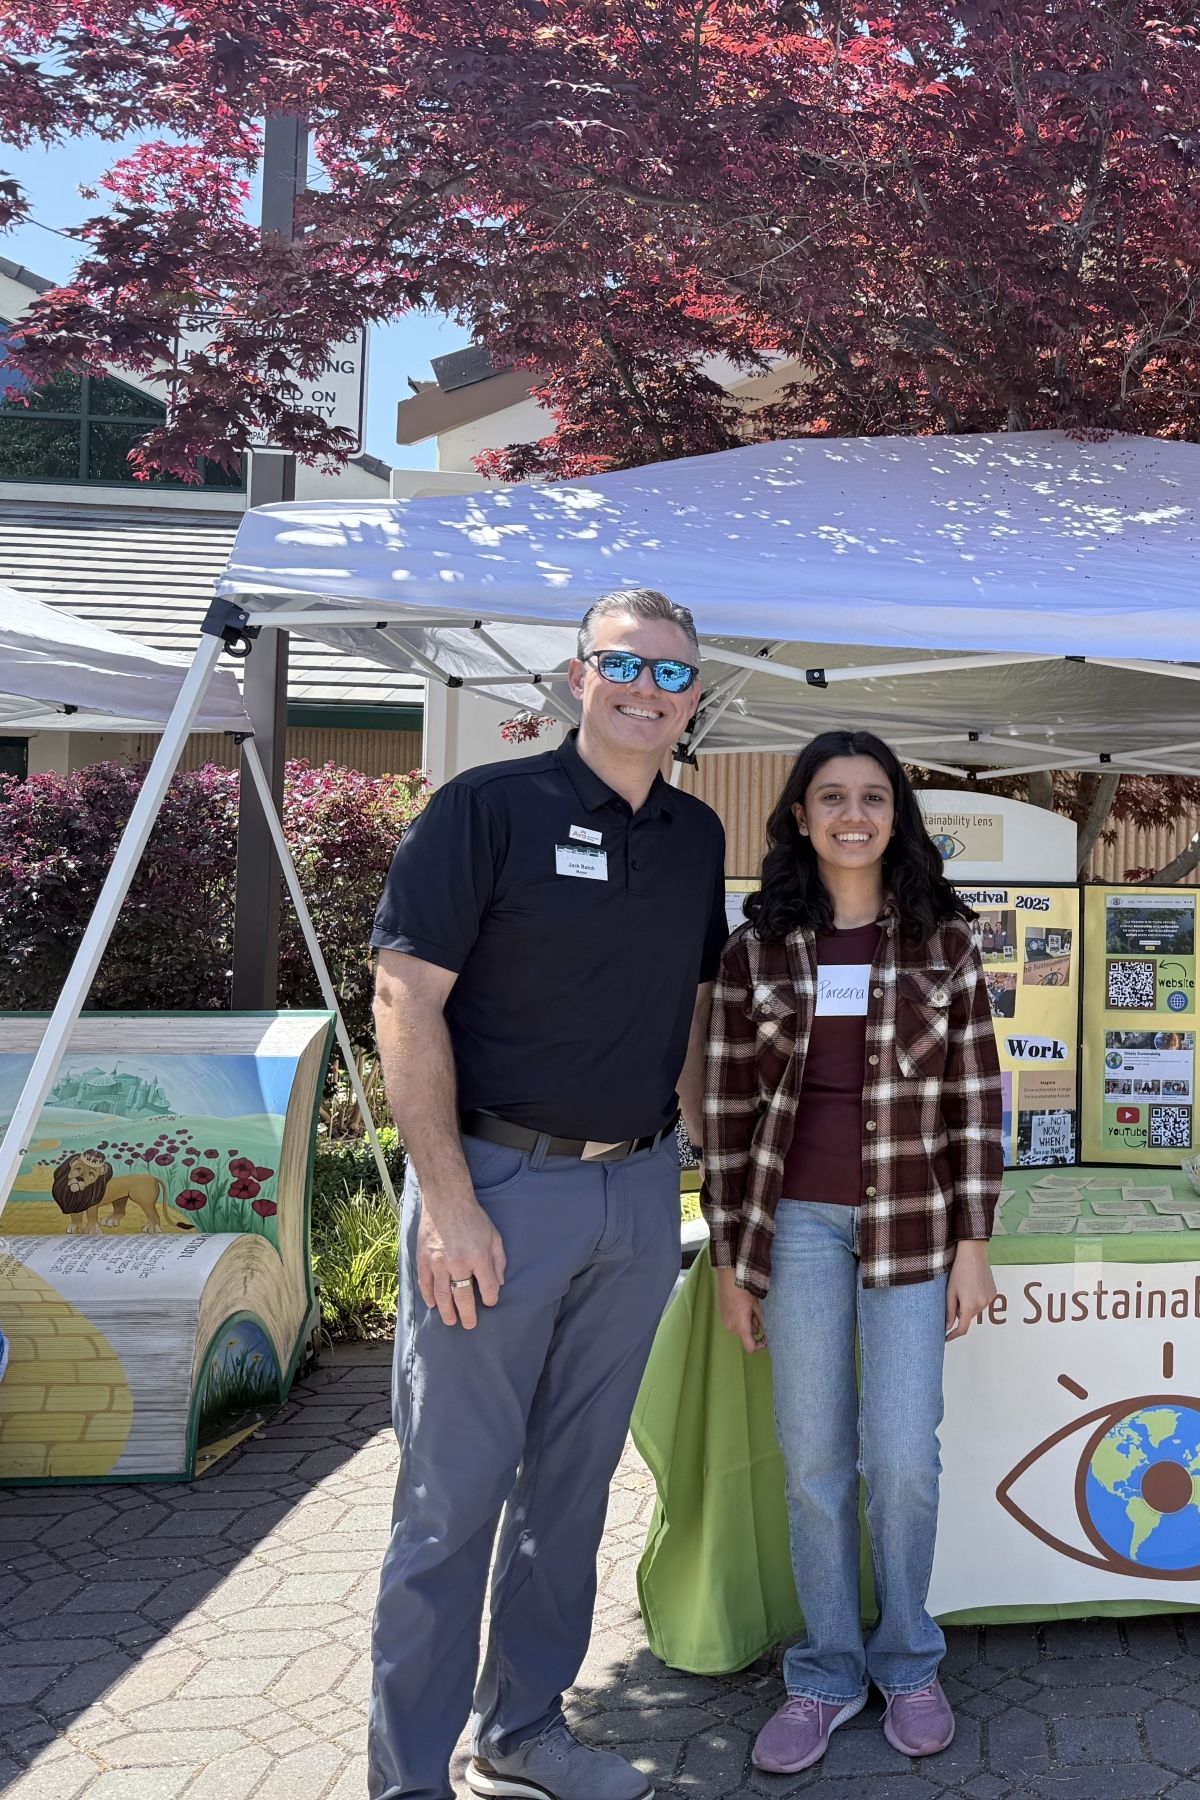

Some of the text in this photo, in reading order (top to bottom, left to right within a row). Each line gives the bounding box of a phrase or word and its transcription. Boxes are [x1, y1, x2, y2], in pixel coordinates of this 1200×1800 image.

[311, 391, 336, 403] ON
[924, 814, 993, 829] tainability Lens
[1015, 896, 1050, 911] 2025
[1006, 1038, 1065, 1059] Work
[1037, 1115, 1067, 1126] IF NOT
[1108, 1127, 1147, 1136] YouTube
[1039, 1135, 1066, 1147] WHEN?
